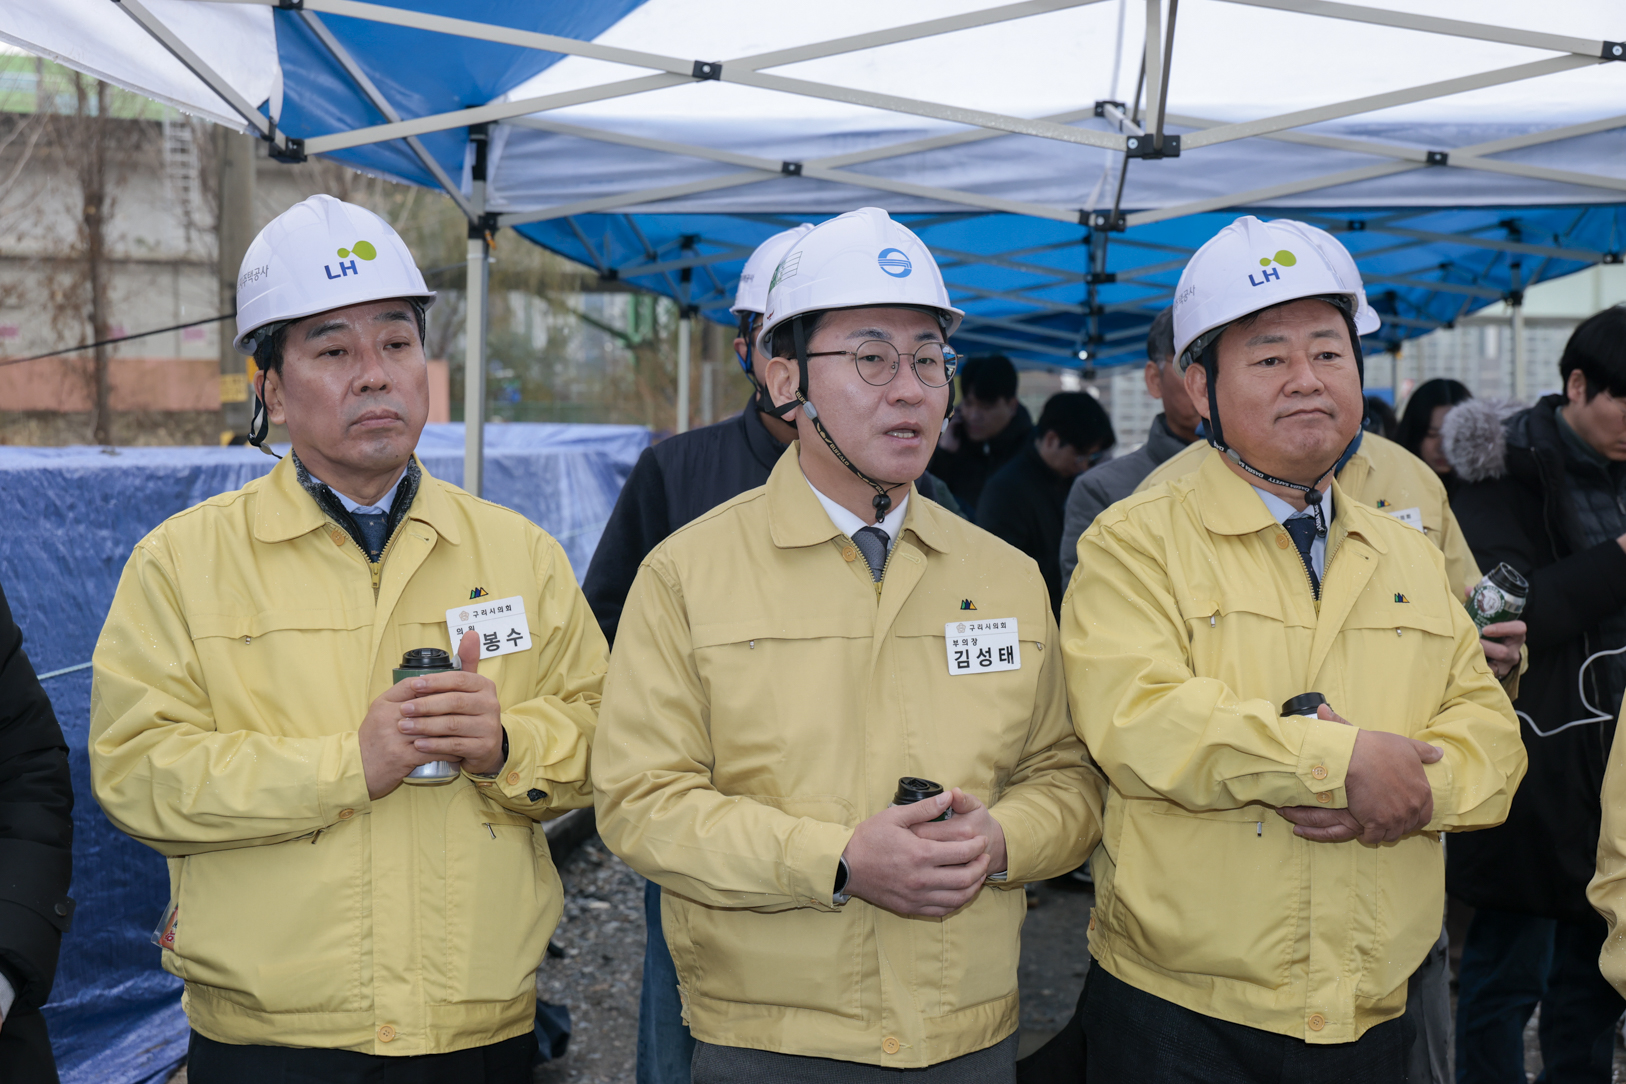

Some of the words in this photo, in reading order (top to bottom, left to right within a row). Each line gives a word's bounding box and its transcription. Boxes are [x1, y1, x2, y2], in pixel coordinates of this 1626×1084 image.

[324, 259, 359, 280] LH
[1248, 267, 1281, 287] LH
[829, 443, 850, 466] BUFFALO
[472, 604, 512, 618] 구리시의회
[969, 622, 1007, 632] 구리시의회
[460, 628, 523, 652] 봉수
[952, 638, 978, 647] 부의장
[954, 645, 1014, 669] 김성태
